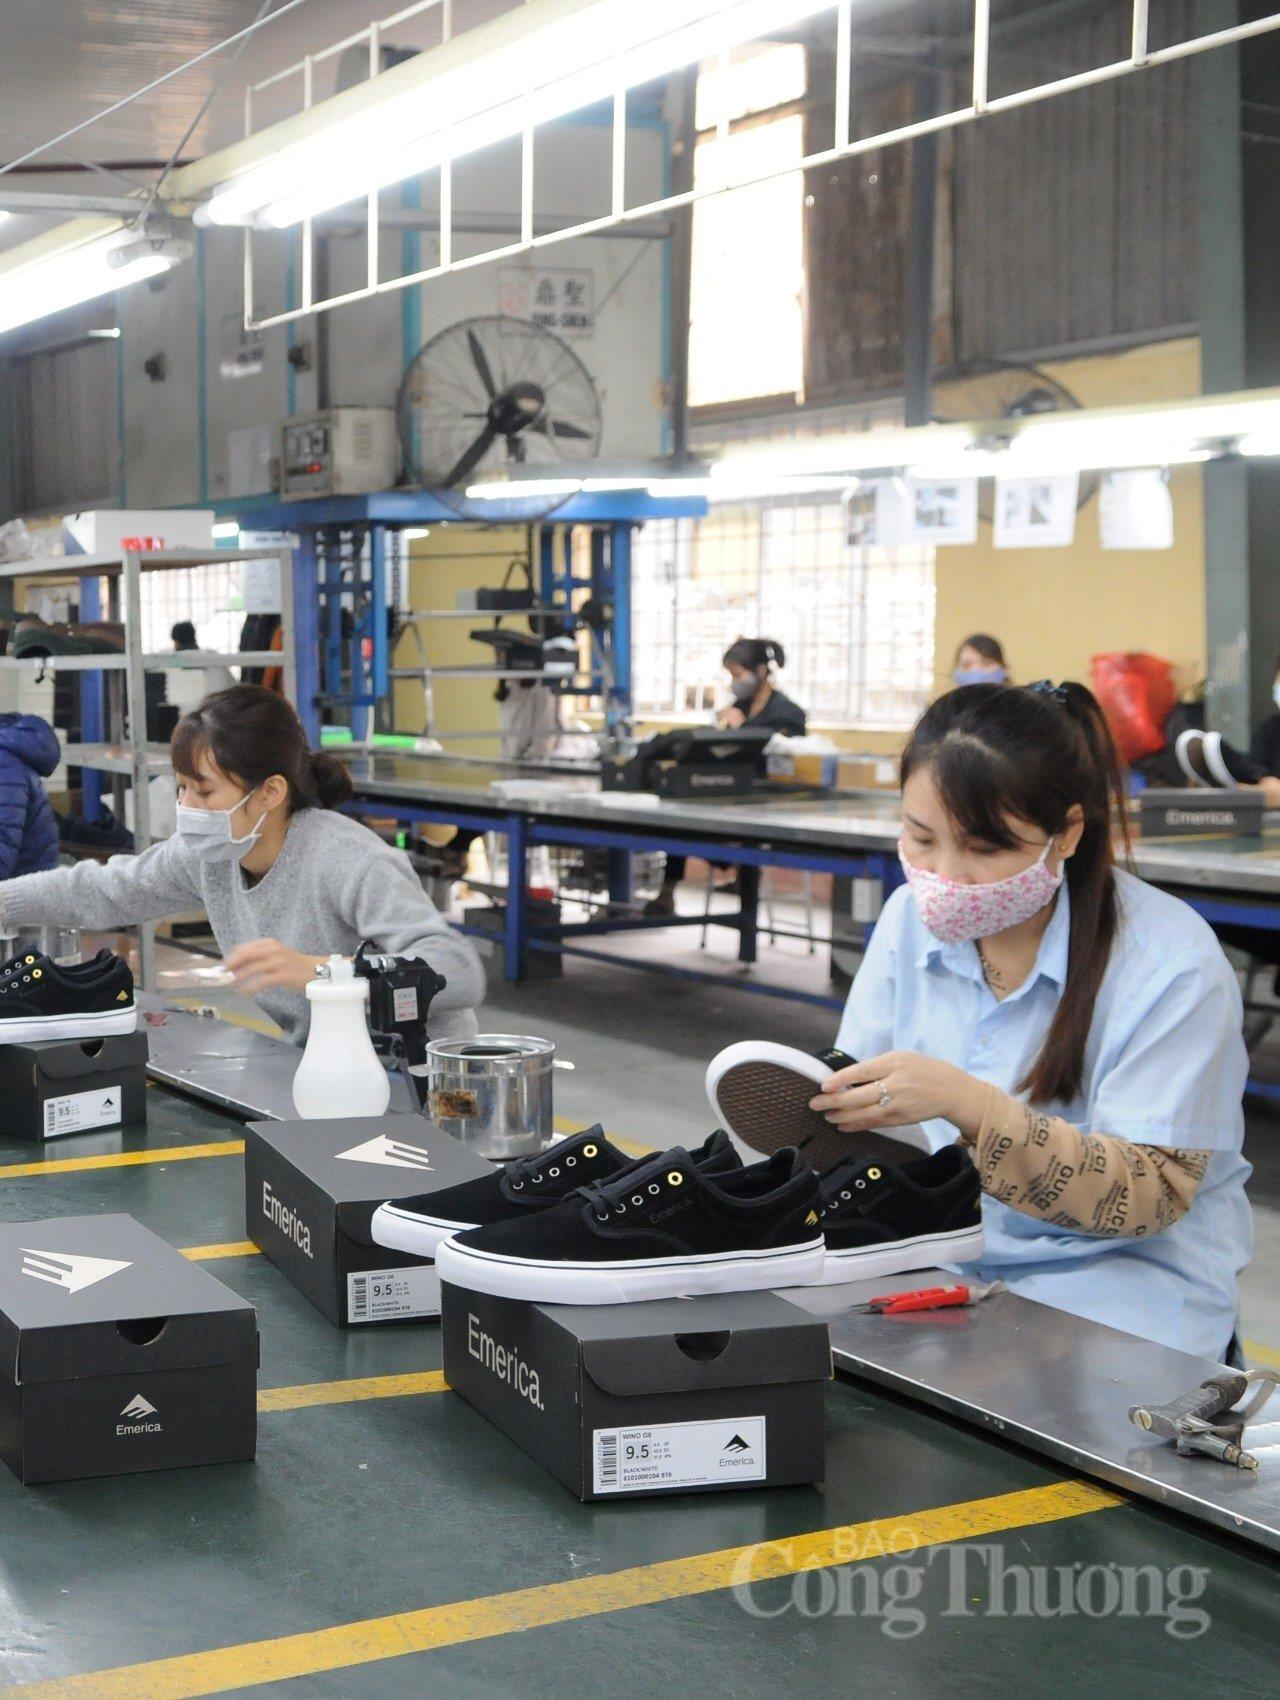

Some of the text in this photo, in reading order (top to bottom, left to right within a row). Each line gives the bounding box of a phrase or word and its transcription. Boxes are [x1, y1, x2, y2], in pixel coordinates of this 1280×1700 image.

[58, 1106, 70, 1117] 9.5
[263, 1181, 314, 1259] Emerica.
[373, 1284, 392, 1297] 9.5
[468, 1312, 545, 1411] Emerica.
[116, 1421, 164, 1436] Emerica.
[626, 1444, 649, 1460] 9.5
[719, 1458, 755, 1467] Emerica.
[623, 1466, 658, 1474] BLACK/WHITE
